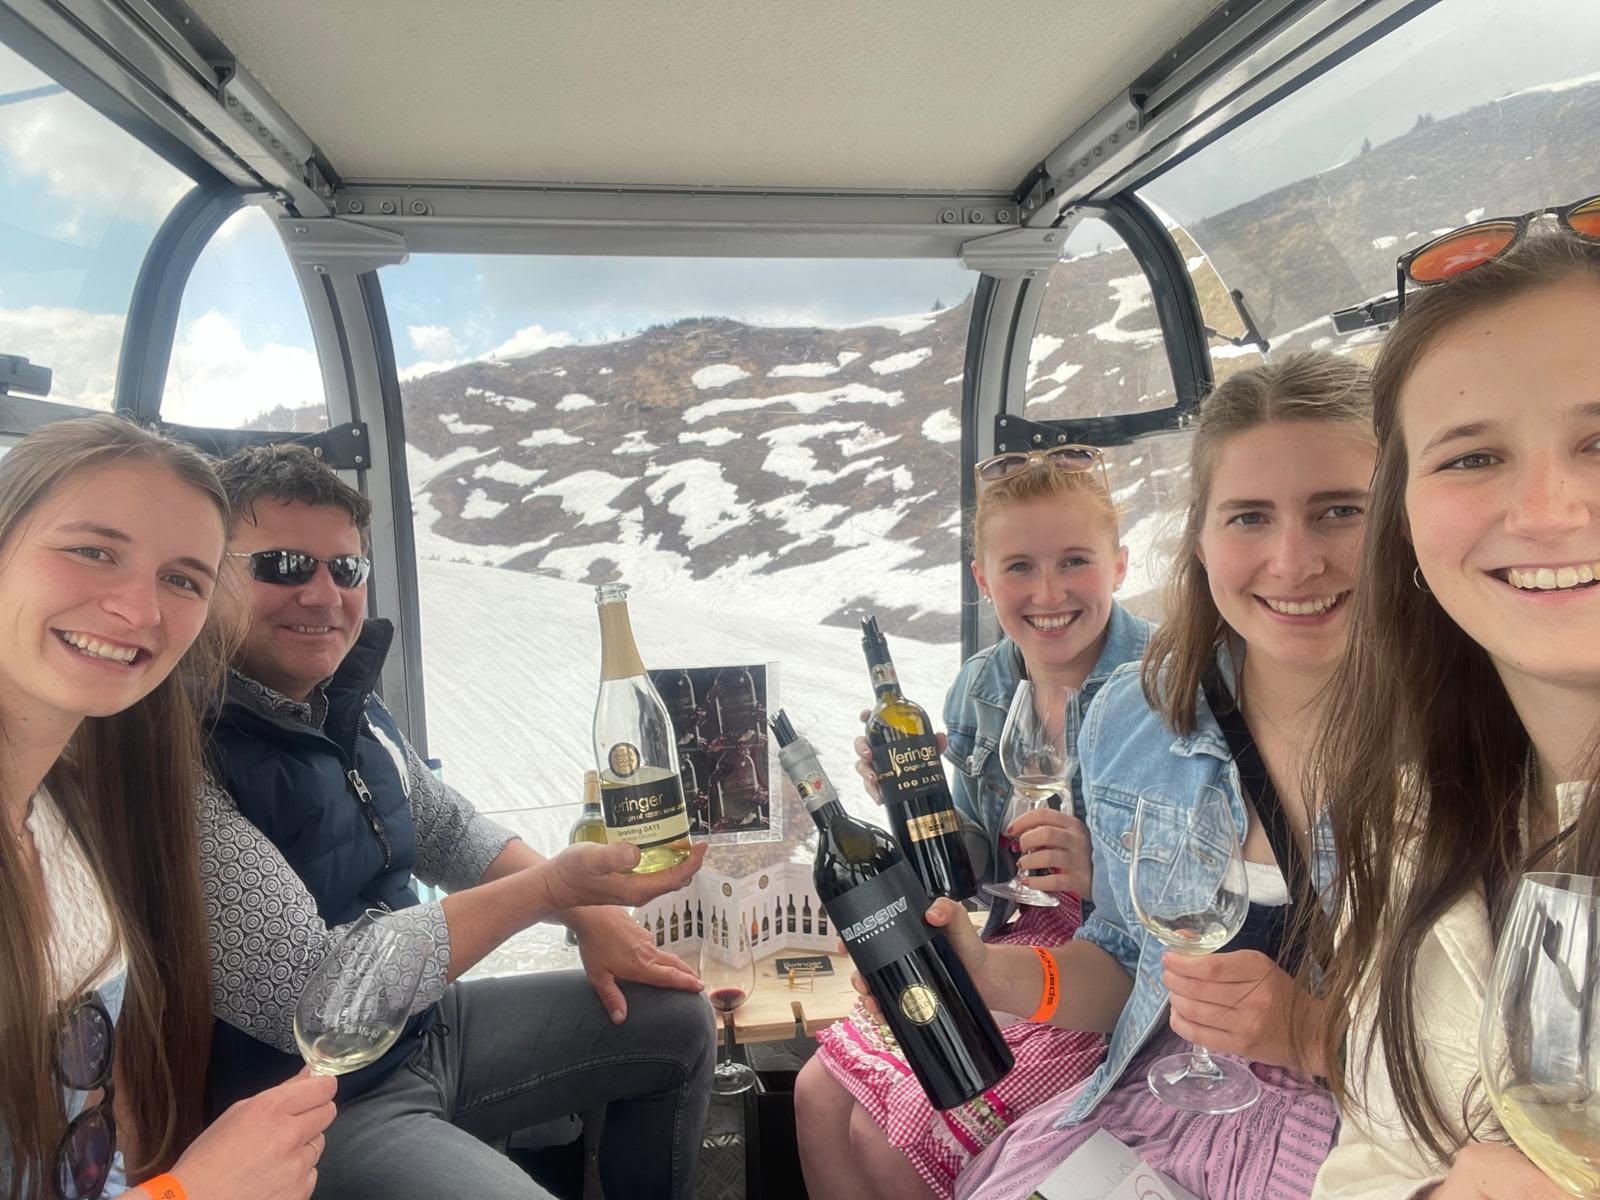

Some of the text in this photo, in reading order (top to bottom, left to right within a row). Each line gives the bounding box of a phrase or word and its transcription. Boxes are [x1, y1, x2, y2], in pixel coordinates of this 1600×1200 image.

[897, 780, 918, 790] 100
[611, 792, 664, 818] eringer
[841, 896, 908, 942] MASSIV
